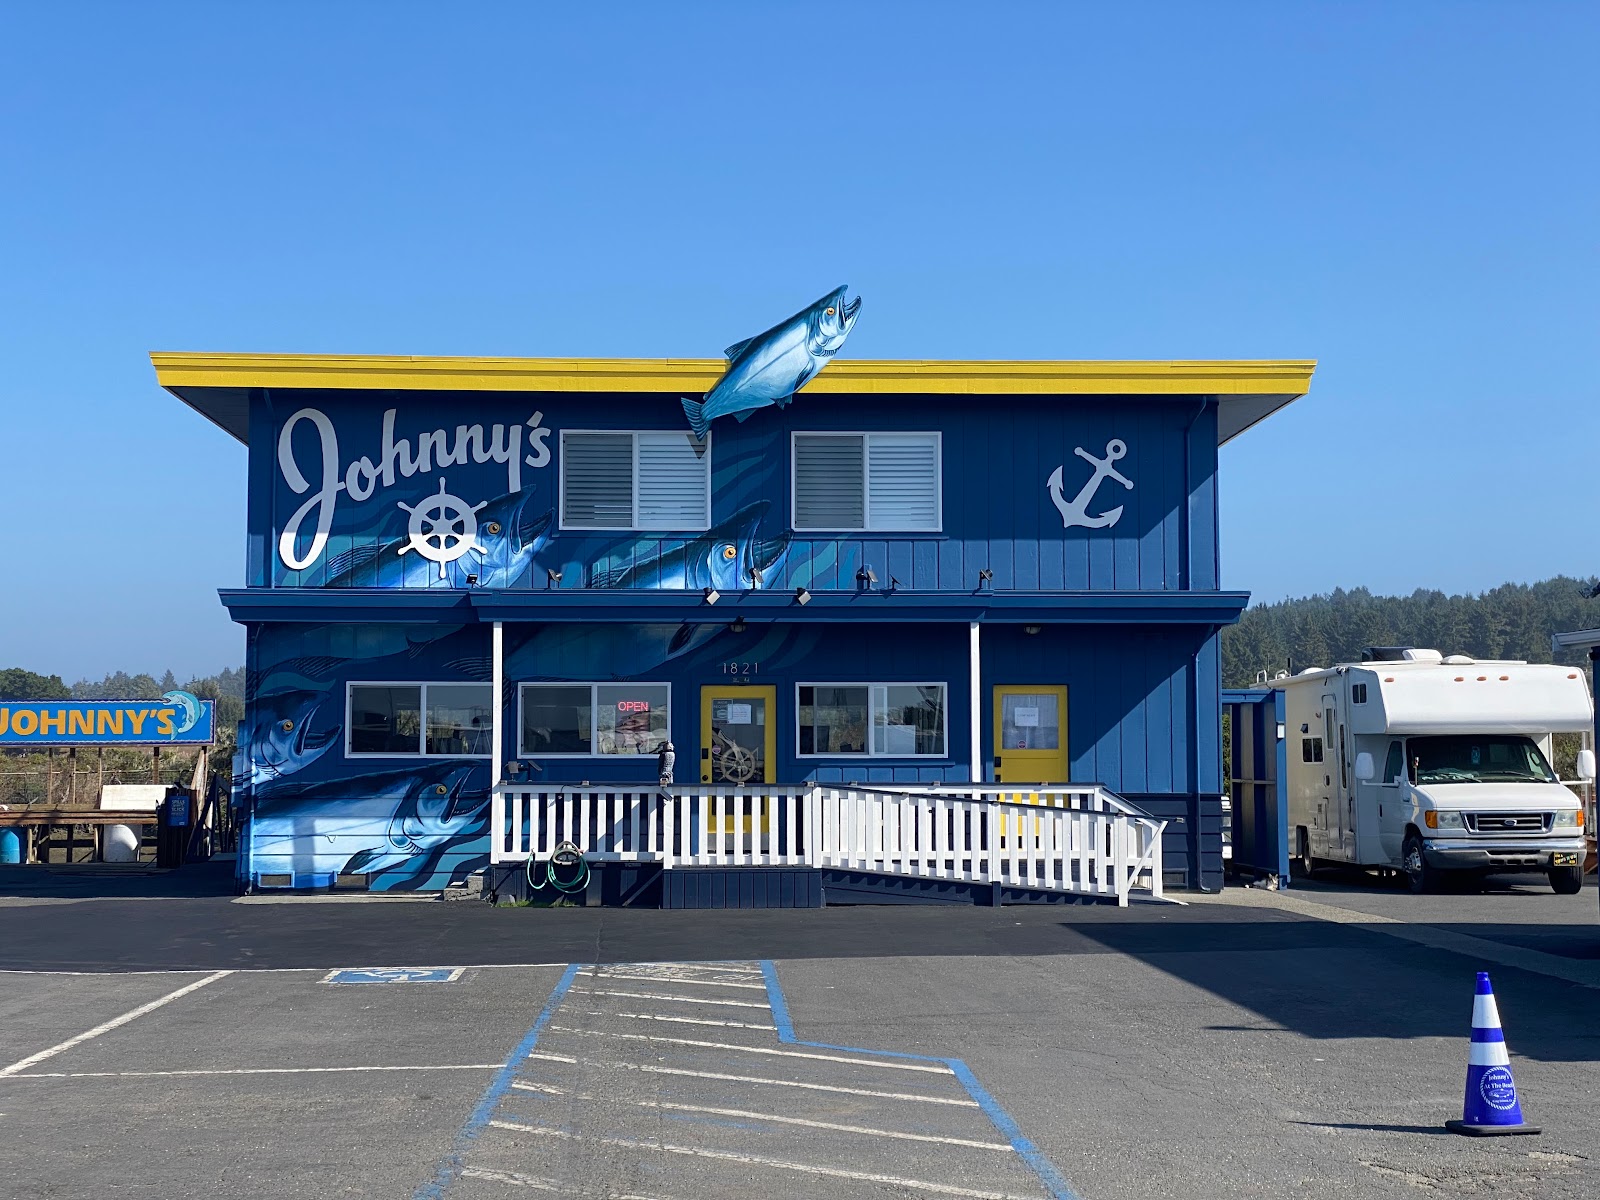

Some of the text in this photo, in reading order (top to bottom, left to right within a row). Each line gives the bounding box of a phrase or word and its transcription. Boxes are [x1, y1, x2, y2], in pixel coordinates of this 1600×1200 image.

[278, 407, 551, 570] Johnny's
[723, 662, 758, 675] 1821
[618, 701, 649, 712] OPEN
[0, 707, 176, 736] JOHNNY'S
